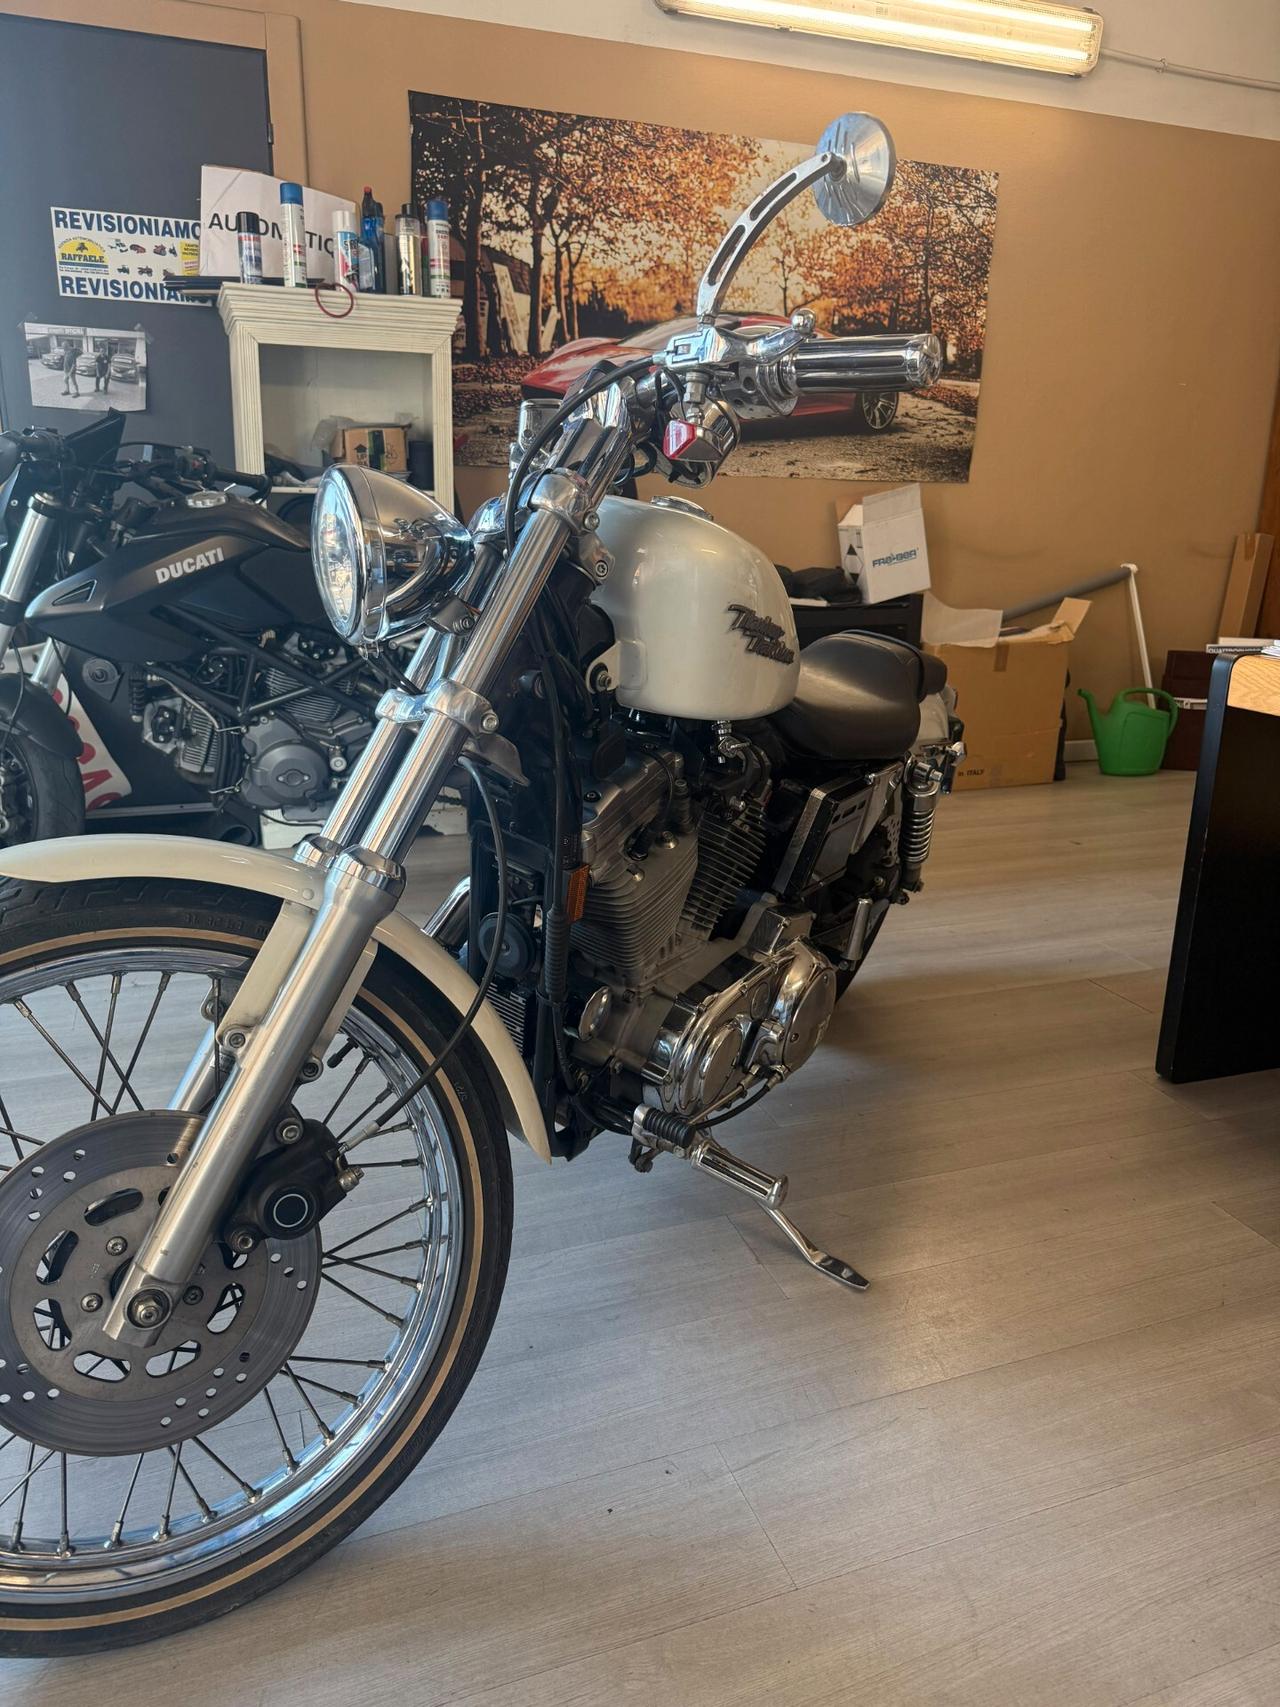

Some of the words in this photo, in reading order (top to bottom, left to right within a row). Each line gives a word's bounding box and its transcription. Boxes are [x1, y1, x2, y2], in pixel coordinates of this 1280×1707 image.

[61, 253, 105, 263] RAFFAELE
[60, 275, 209, 304] REVISIONIA
[155, 546, 225, 584] DUCATI
